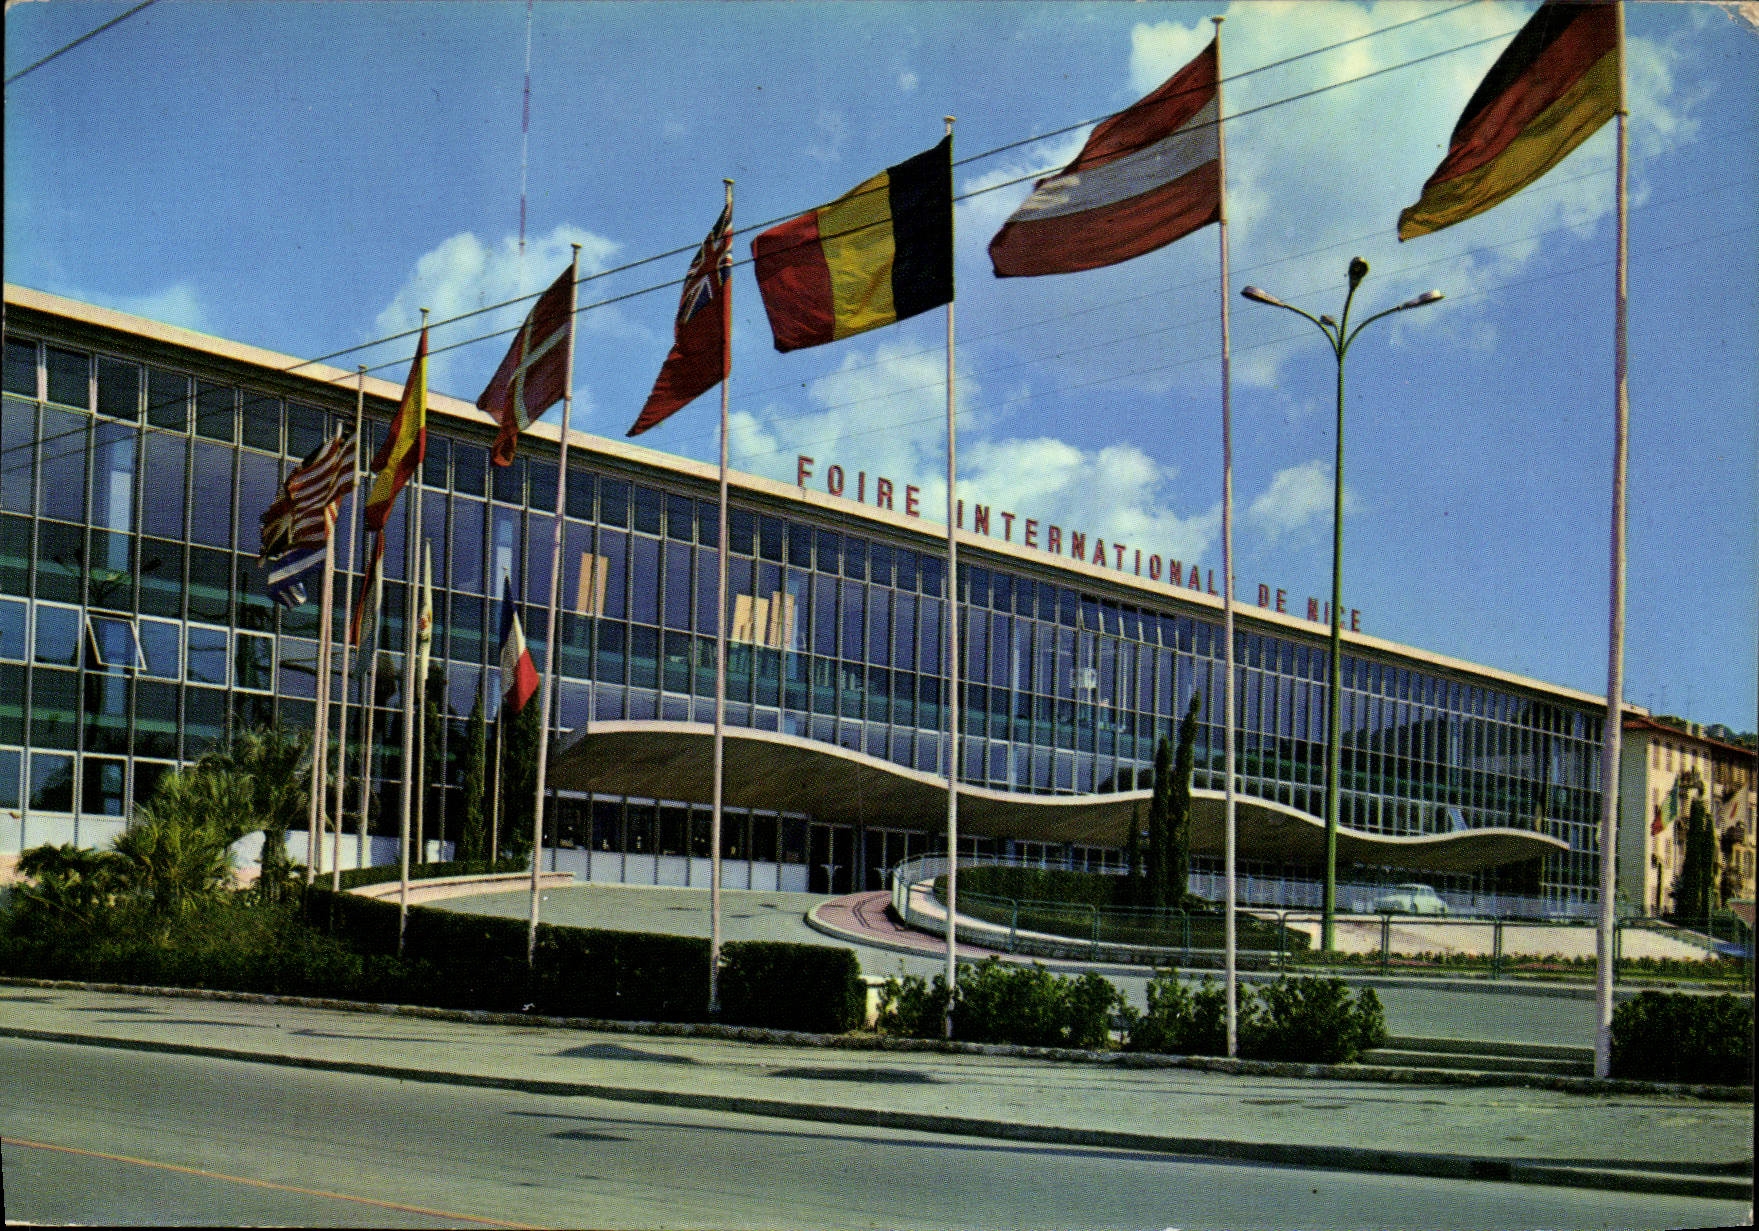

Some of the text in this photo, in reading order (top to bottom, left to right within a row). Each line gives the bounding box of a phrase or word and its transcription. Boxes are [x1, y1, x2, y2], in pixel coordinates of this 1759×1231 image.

[798, 455, 920, 517] FOIRE
[957, 499, 1236, 600] INTERNATIONAL
[1258, 583, 1287, 614] DE
